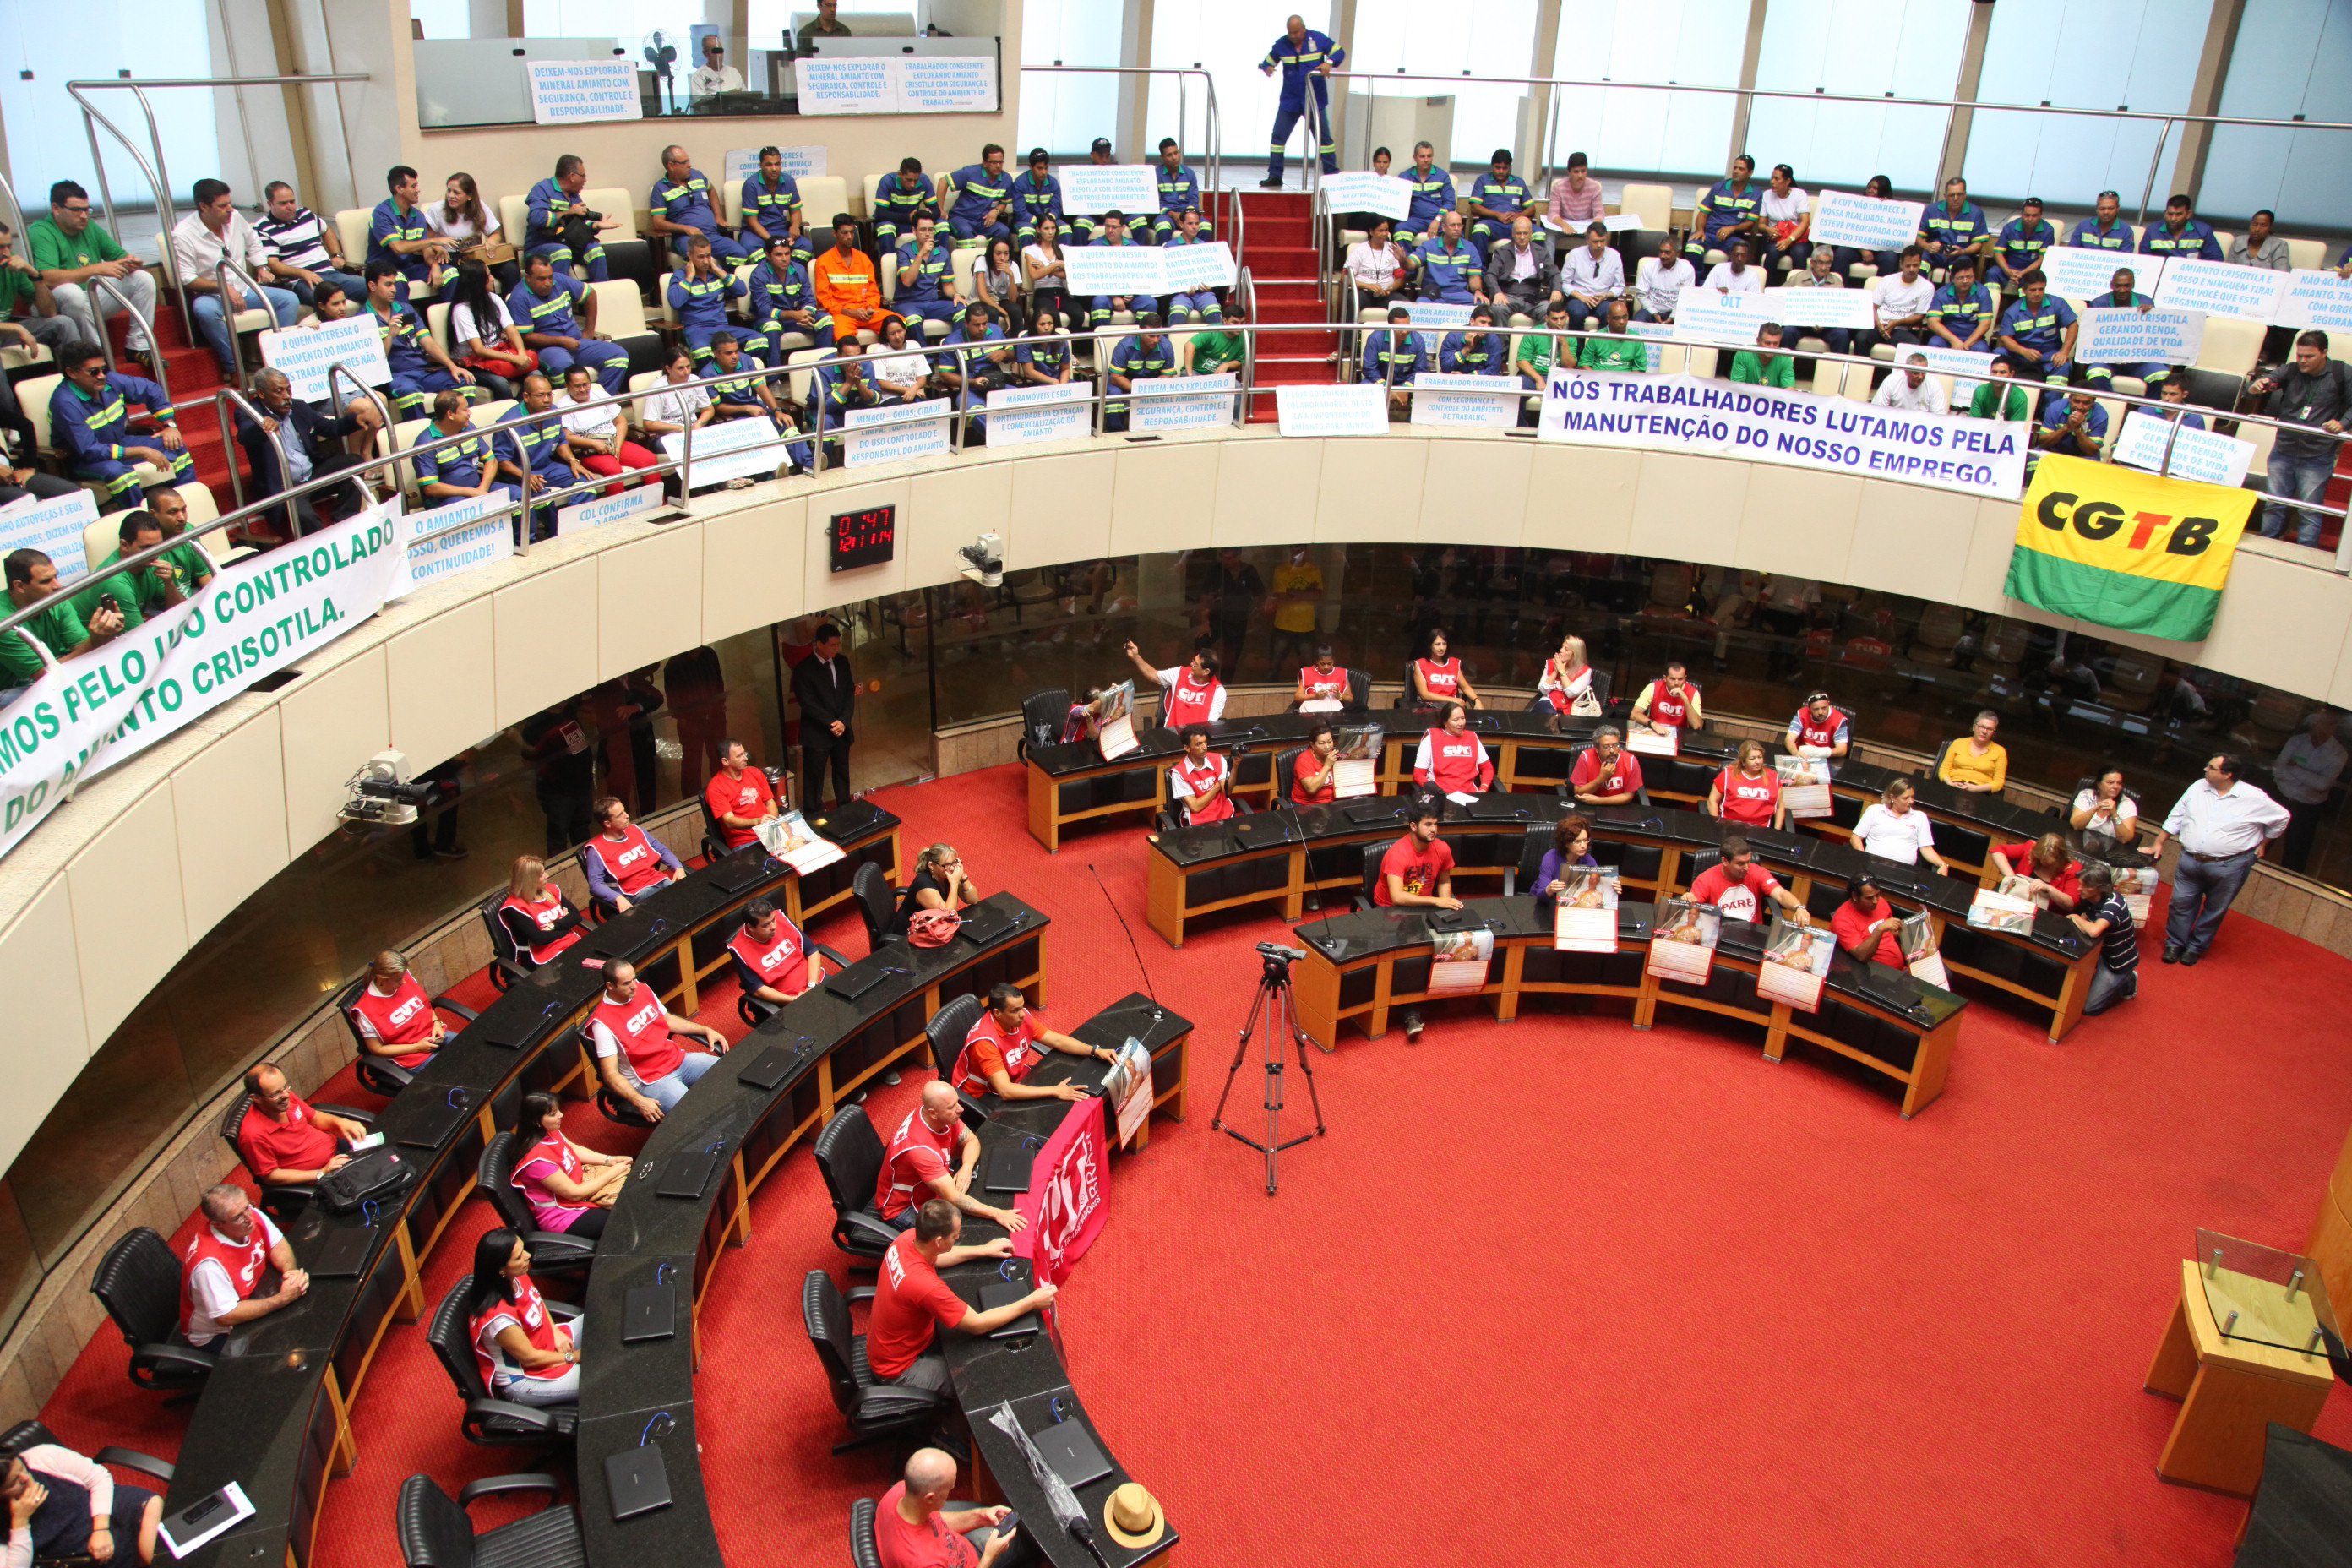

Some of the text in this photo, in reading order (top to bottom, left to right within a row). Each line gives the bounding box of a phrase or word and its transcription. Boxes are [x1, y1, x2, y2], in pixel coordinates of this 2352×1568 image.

[535, 67, 584, 77] DEIXEM-NOS
[585, 66, 623, 75] EXPLORAR
[539, 79, 629, 90] MINERAL AMIANTO COM
[950, 80, 983, 89] SEGURANÇA
[539, 91, 633, 105] SEGURANÇA, CONTROLE E
[816, 90, 881, 99] RESPONSABILIDADE.
[550, 104, 627, 117] RESPONSABILIDADE.
[1821, 207, 1843, 217] NOSSA
[1838, 199, 1899, 213] CUT NÃO CONHECE
[1820, 218, 1908, 237] ESTEVE COM
[1183, 246, 1217, 257] CRISOTILA
[1207, 264, 1223, 273] VIDA
[2059, 269, 2094, 278] REPUDIAM
[2180, 264, 2265, 282] AMIANTO CRISOTILA
[2171, 274, 2198, 286] NOSSO
[2300, 275, 2334, 286] NÃO AO
[2176, 286, 2260, 306] NEM VOCÊ QUE ESTÁ
[2291, 287, 2335, 300] AMIANTO.
[1721, 295, 1741, 308] OLT
[2163, 296, 2208, 310] CHEGANDO
[2307, 302, 2328, 312] COM
[2096, 313, 2187, 324] AMIANTO CRISOTILA
[2099, 325, 2143, 335] GERANDO
[282, 325, 359, 350] A QUEM INTERESSA O
[2093, 337, 2183, 347] QUALIDADE DE VIDA
[275, 338, 373, 368] BANIMENTO DO AMIANTO?
[361, 351, 378, 366] NÃO.
[2083, 349, 2130, 357] E EMPREGO
[1939, 354, 1989, 367] BANIMENTO DO
[308, 381, 325, 393] COM
[1186, 379, 1222, 389] EXPLORAR
[1056, 389, 1072, 398] SEUS
[917, 404, 941, 416] CIDADE
[1185, 402, 1221, 411] CONTROLE
[993, 411, 1041, 422] CONTINUIDADE
[1144, 414, 1218, 426] RESPONSABILIDADE.
[1553, 375, 2015, 456] NÓS TRABALHADORES LUTAMOS PELA
[748, 431, 763, 442] COM
[859, 429, 937, 449] DO USO CONTROLADO E
[1023, 427, 1054, 438] AMIANTO.
[902, 440, 944, 454] DO AMIANTO
[1563, 411, 1998, 487] MANUTENÇÃO DO NOSSO EMPREGO.
[2129, 450, 2134, 459] E
[2206, 457, 2229, 472] VIDA
[64, 502, 83, 515] SEUS
[580, 494, 642, 521] CDL CONFIRMA
[416, 506, 476, 534] O AMIANTO
[2037, 491, 2219, 556] CGTB
[46, 525, 69, 540] DIZEM
[439, 519, 505, 550] QUEREMOS A
[411, 543, 494, 580] CONTINUIDADE!
[63, 518, 395, 723] PELO CONTROLADO
[1429, 673, 1455, 683] CUT
[1178, 688, 1206, 701] CUT
[1658, 701, 1682, 715] CUT
[4, 596, 346, 834] DO CRISOTILA.
[1805, 727, 1827, 743] CUT
[1443, 744, 1469, 755] CUT
[1737, 787, 1767, 798] CUT
[618, 845, 646, 865] CUT
[1721, 897, 1755, 912] PARE
[536, 904, 564, 923] CUT
[761, 939, 792, 967] CUT
[389, 996, 422, 1025] CUT
[626, 1004, 656, 1032] CUT
[887, 1244, 906, 1283] CUT
